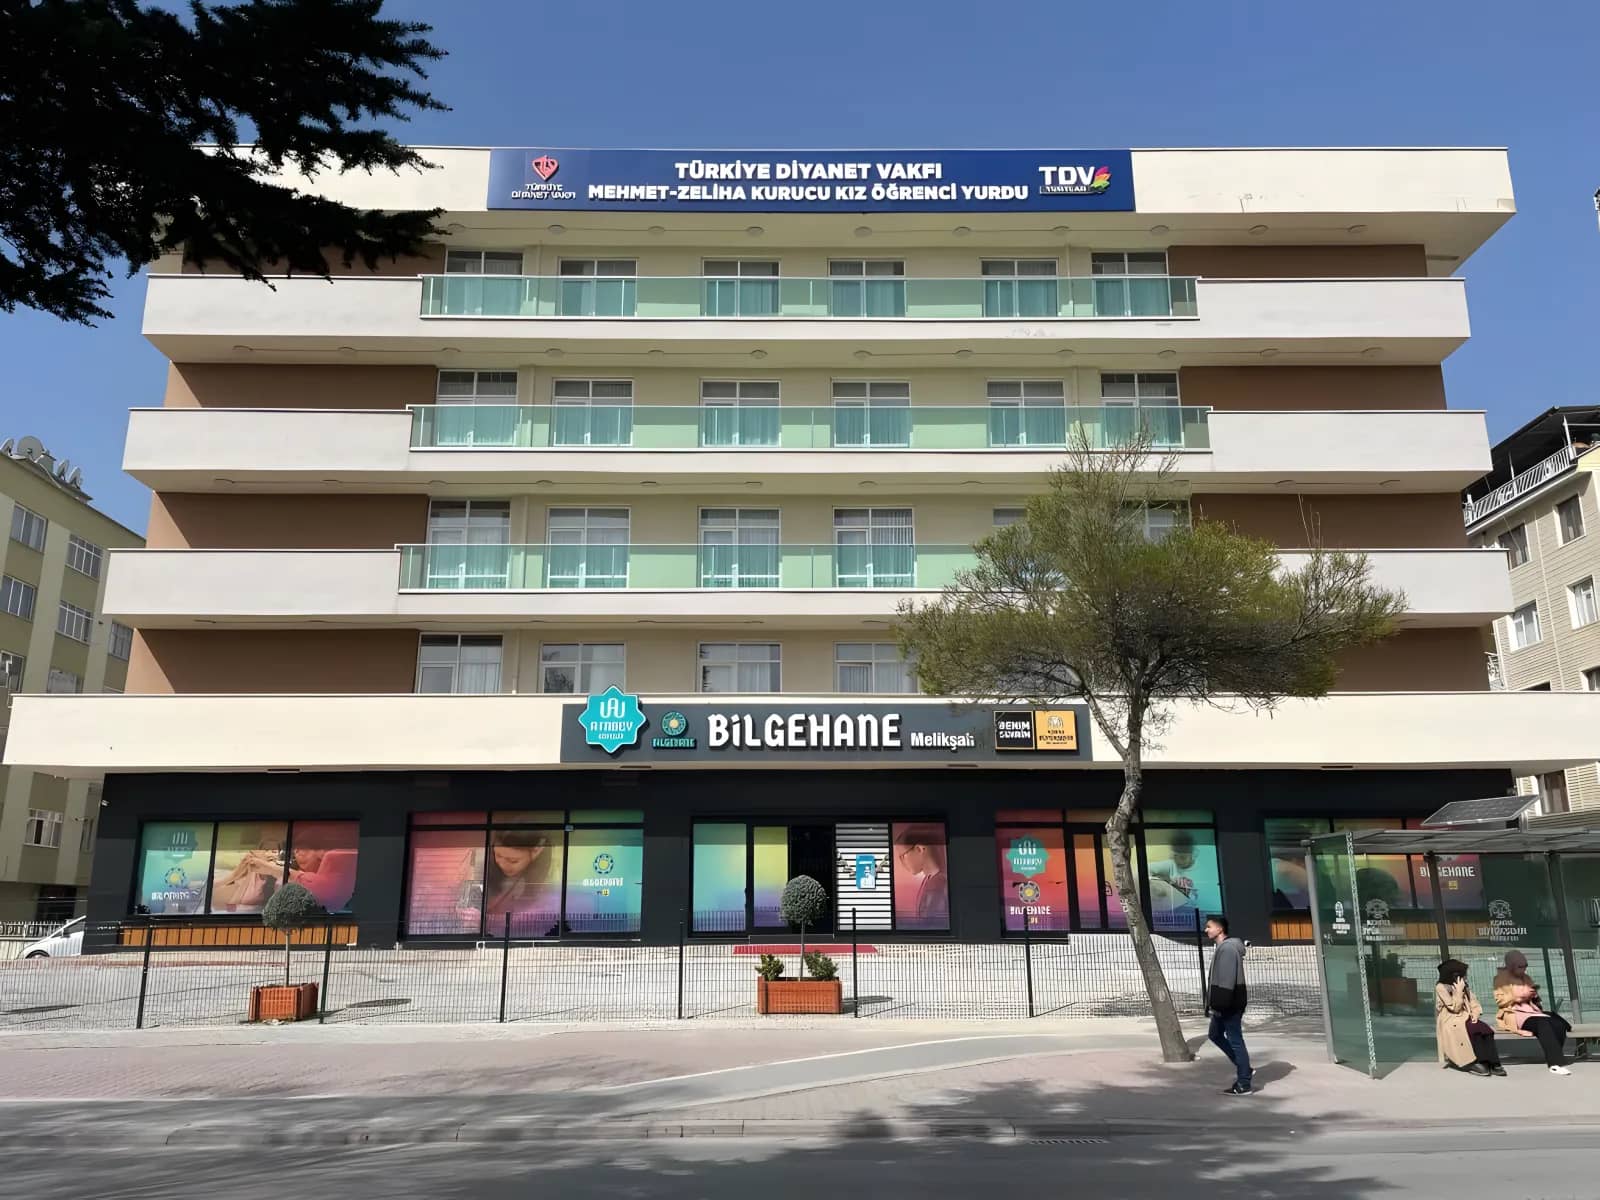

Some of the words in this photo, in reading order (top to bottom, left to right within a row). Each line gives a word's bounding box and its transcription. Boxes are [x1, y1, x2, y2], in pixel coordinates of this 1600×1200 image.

[675, 159, 770, 180] TÜRKİYE
[775, 159, 871, 180] DİYANET
[876, 162, 942, 180] VAKFI
[1038, 166, 1095, 186] TDV
[588, 182, 747, 201] MEHMET-ZELİHA
[751, 185, 831, 201] KURUCU
[835, 185, 867, 200] KIZ
[871, 182, 957, 201] ÖĞRENCİ
[961, 185, 1029, 200] YURDU
